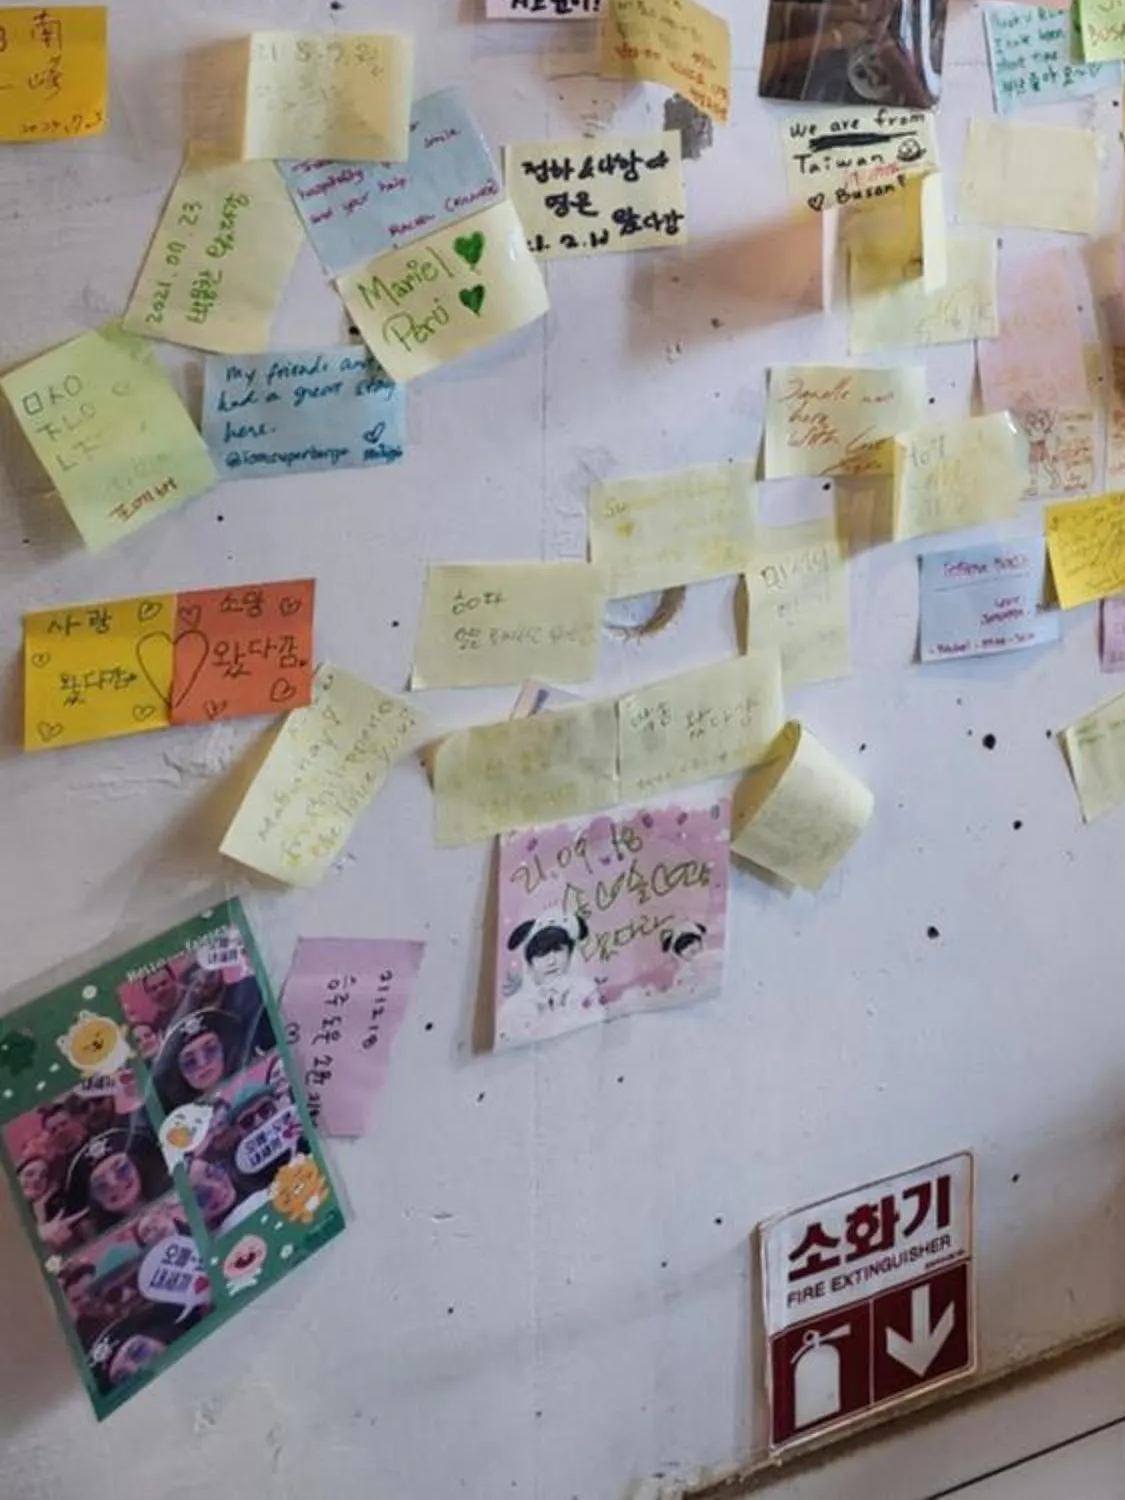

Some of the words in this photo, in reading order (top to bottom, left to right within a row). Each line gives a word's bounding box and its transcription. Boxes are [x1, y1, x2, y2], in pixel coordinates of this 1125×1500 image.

[829, 117, 860, 132] are
[873, 107, 925, 128] from
[792, 153, 884, 176] Taiwan
[787, 1173, 952, 1283] 소화기
[786, 1281, 826, 1308] FIRE
[831, 1233, 953, 1291] EXTINGUISHER
